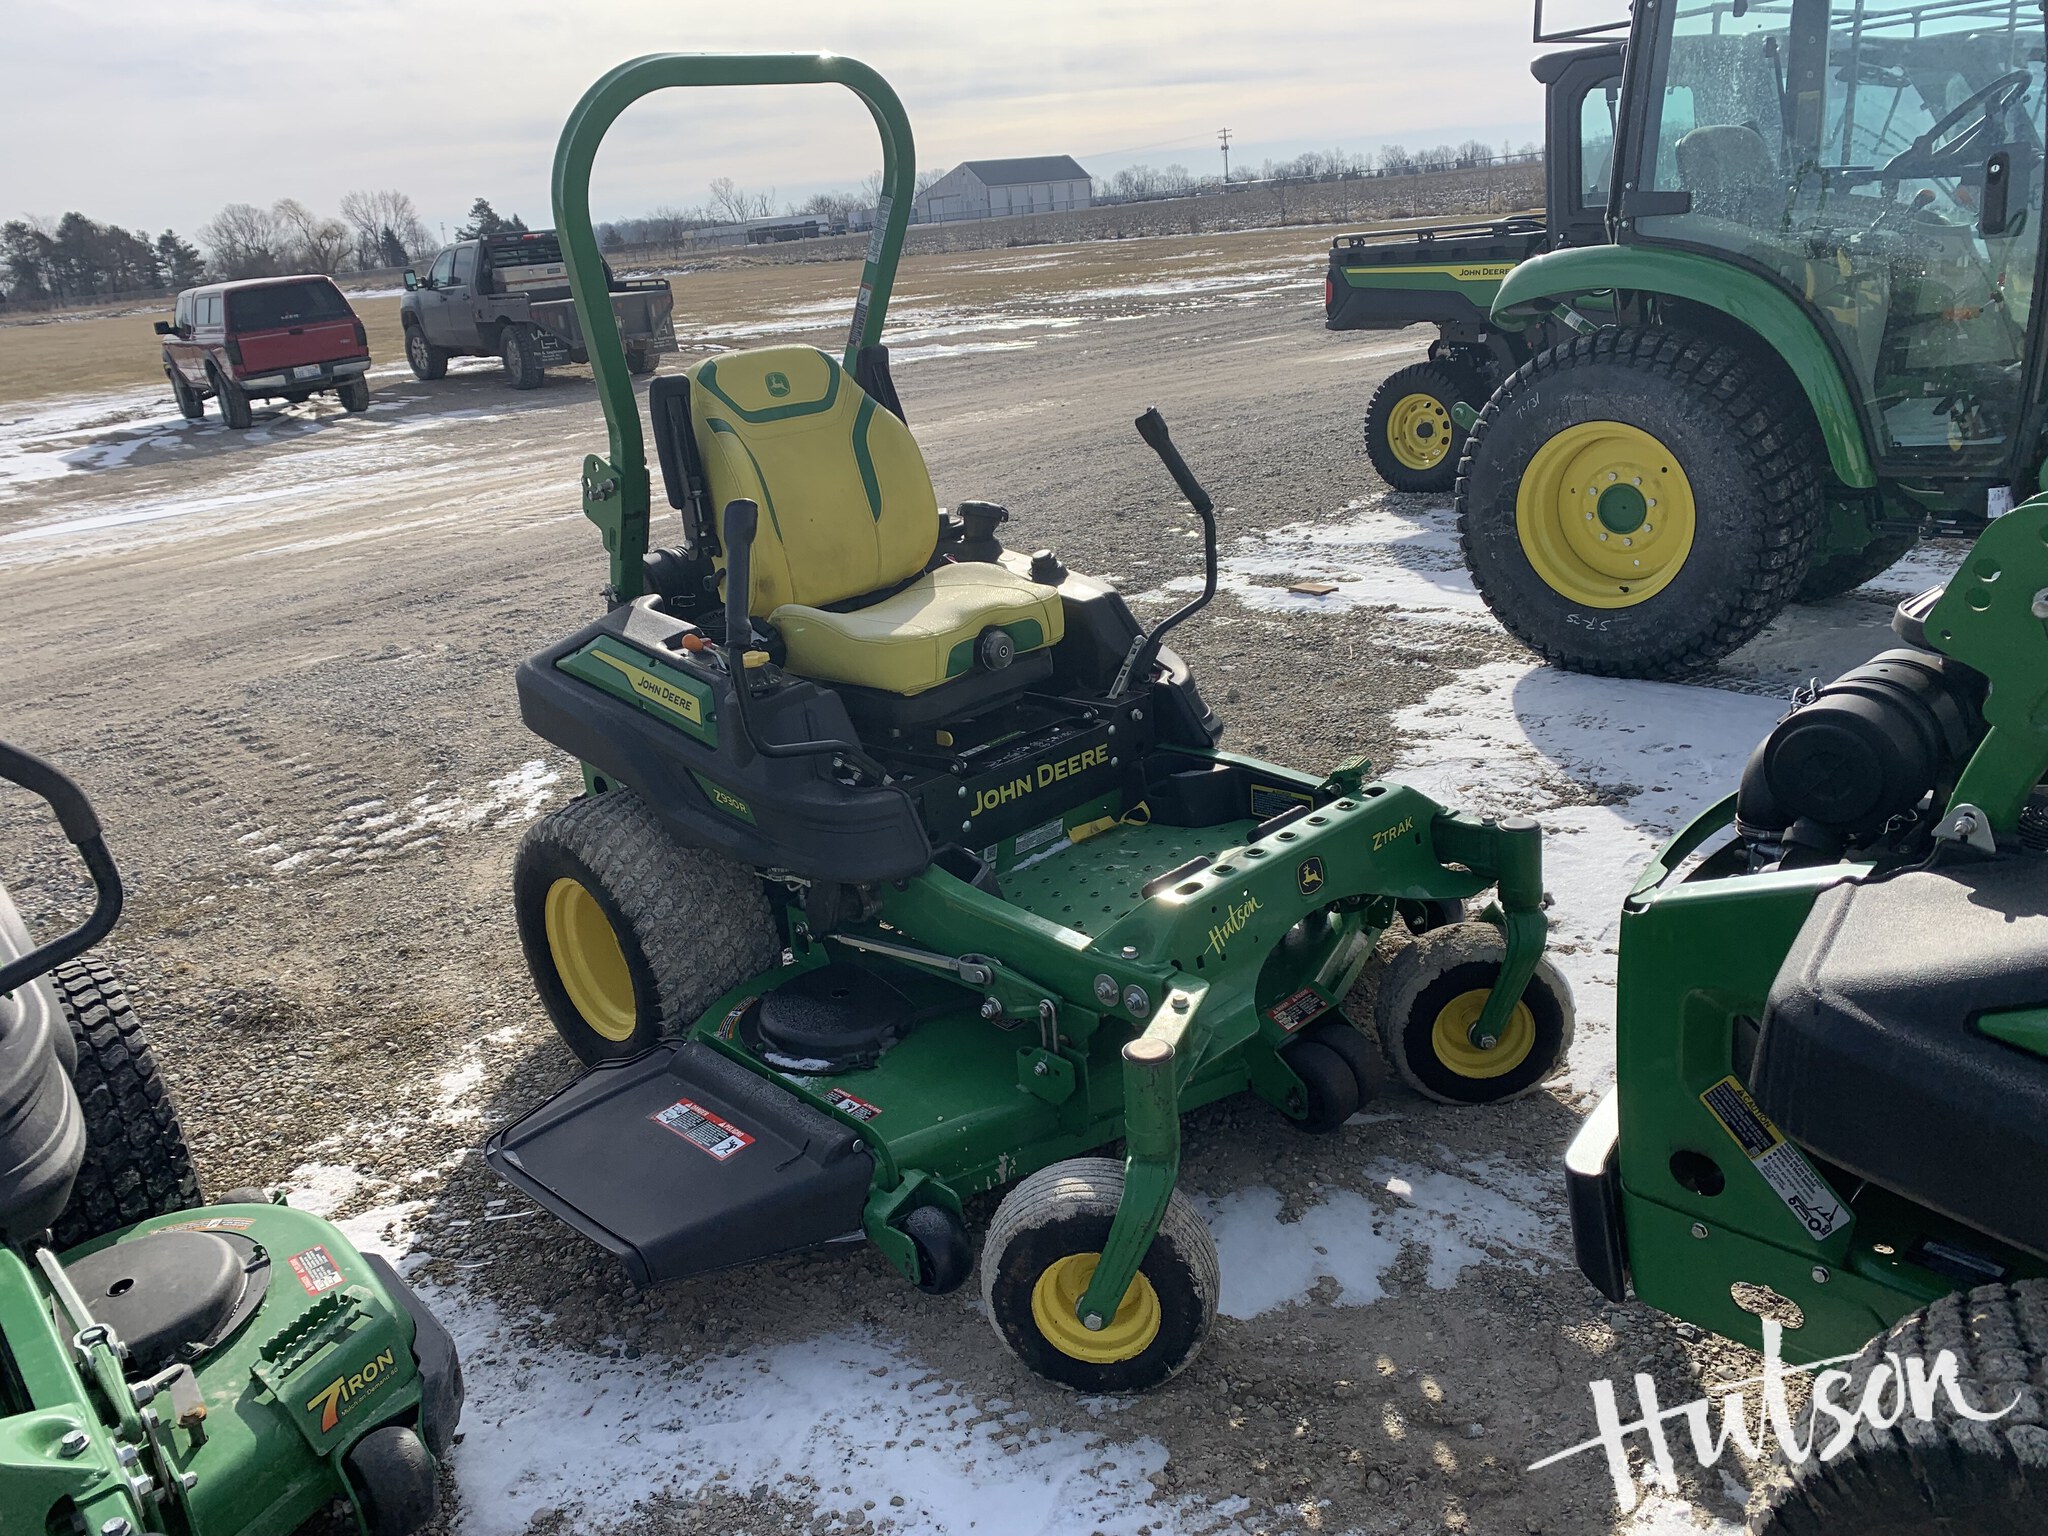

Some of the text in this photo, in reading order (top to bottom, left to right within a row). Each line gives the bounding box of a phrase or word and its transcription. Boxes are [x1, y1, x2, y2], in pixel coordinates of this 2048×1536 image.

[1459, 267, 1510, 276] JOHN DEERE
[638, 676, 693, 711] JOHN DEERE
[970, 774, 1033, 817] JOHN
[1037, 743, 1109, 789] DEERE
[1372, 815, 1414, 851] ZTRAK
[1204, 896, 1264, 955] Hutson
[689, 1103, 710, 1117] DANGER
[1742, 1094, 1772, 1128] CAUTION
[723, 1122, 745, 1138] PELIGRO
